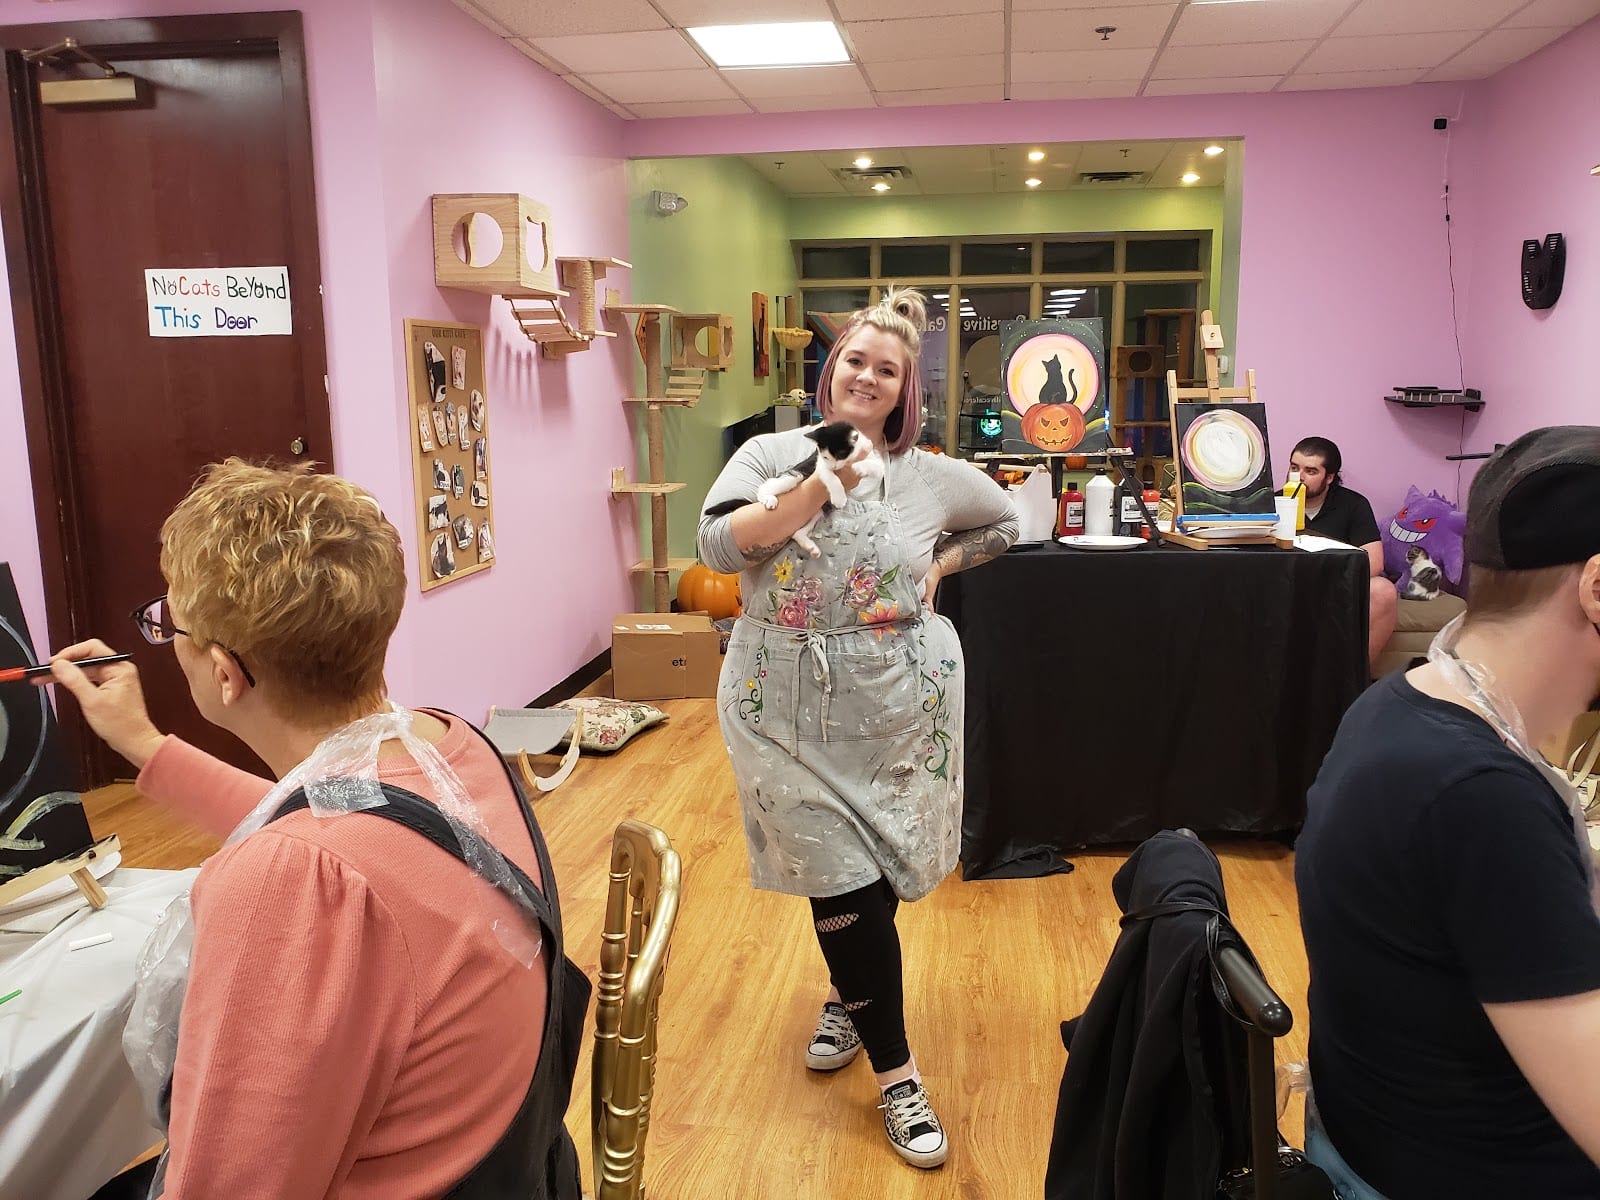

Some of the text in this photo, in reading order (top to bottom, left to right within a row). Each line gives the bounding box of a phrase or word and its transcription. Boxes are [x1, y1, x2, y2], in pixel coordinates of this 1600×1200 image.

[152, 276, 177, 296] No
[179, 276, 221, 297] Cats
[154, 305, 258, 330] This Door
